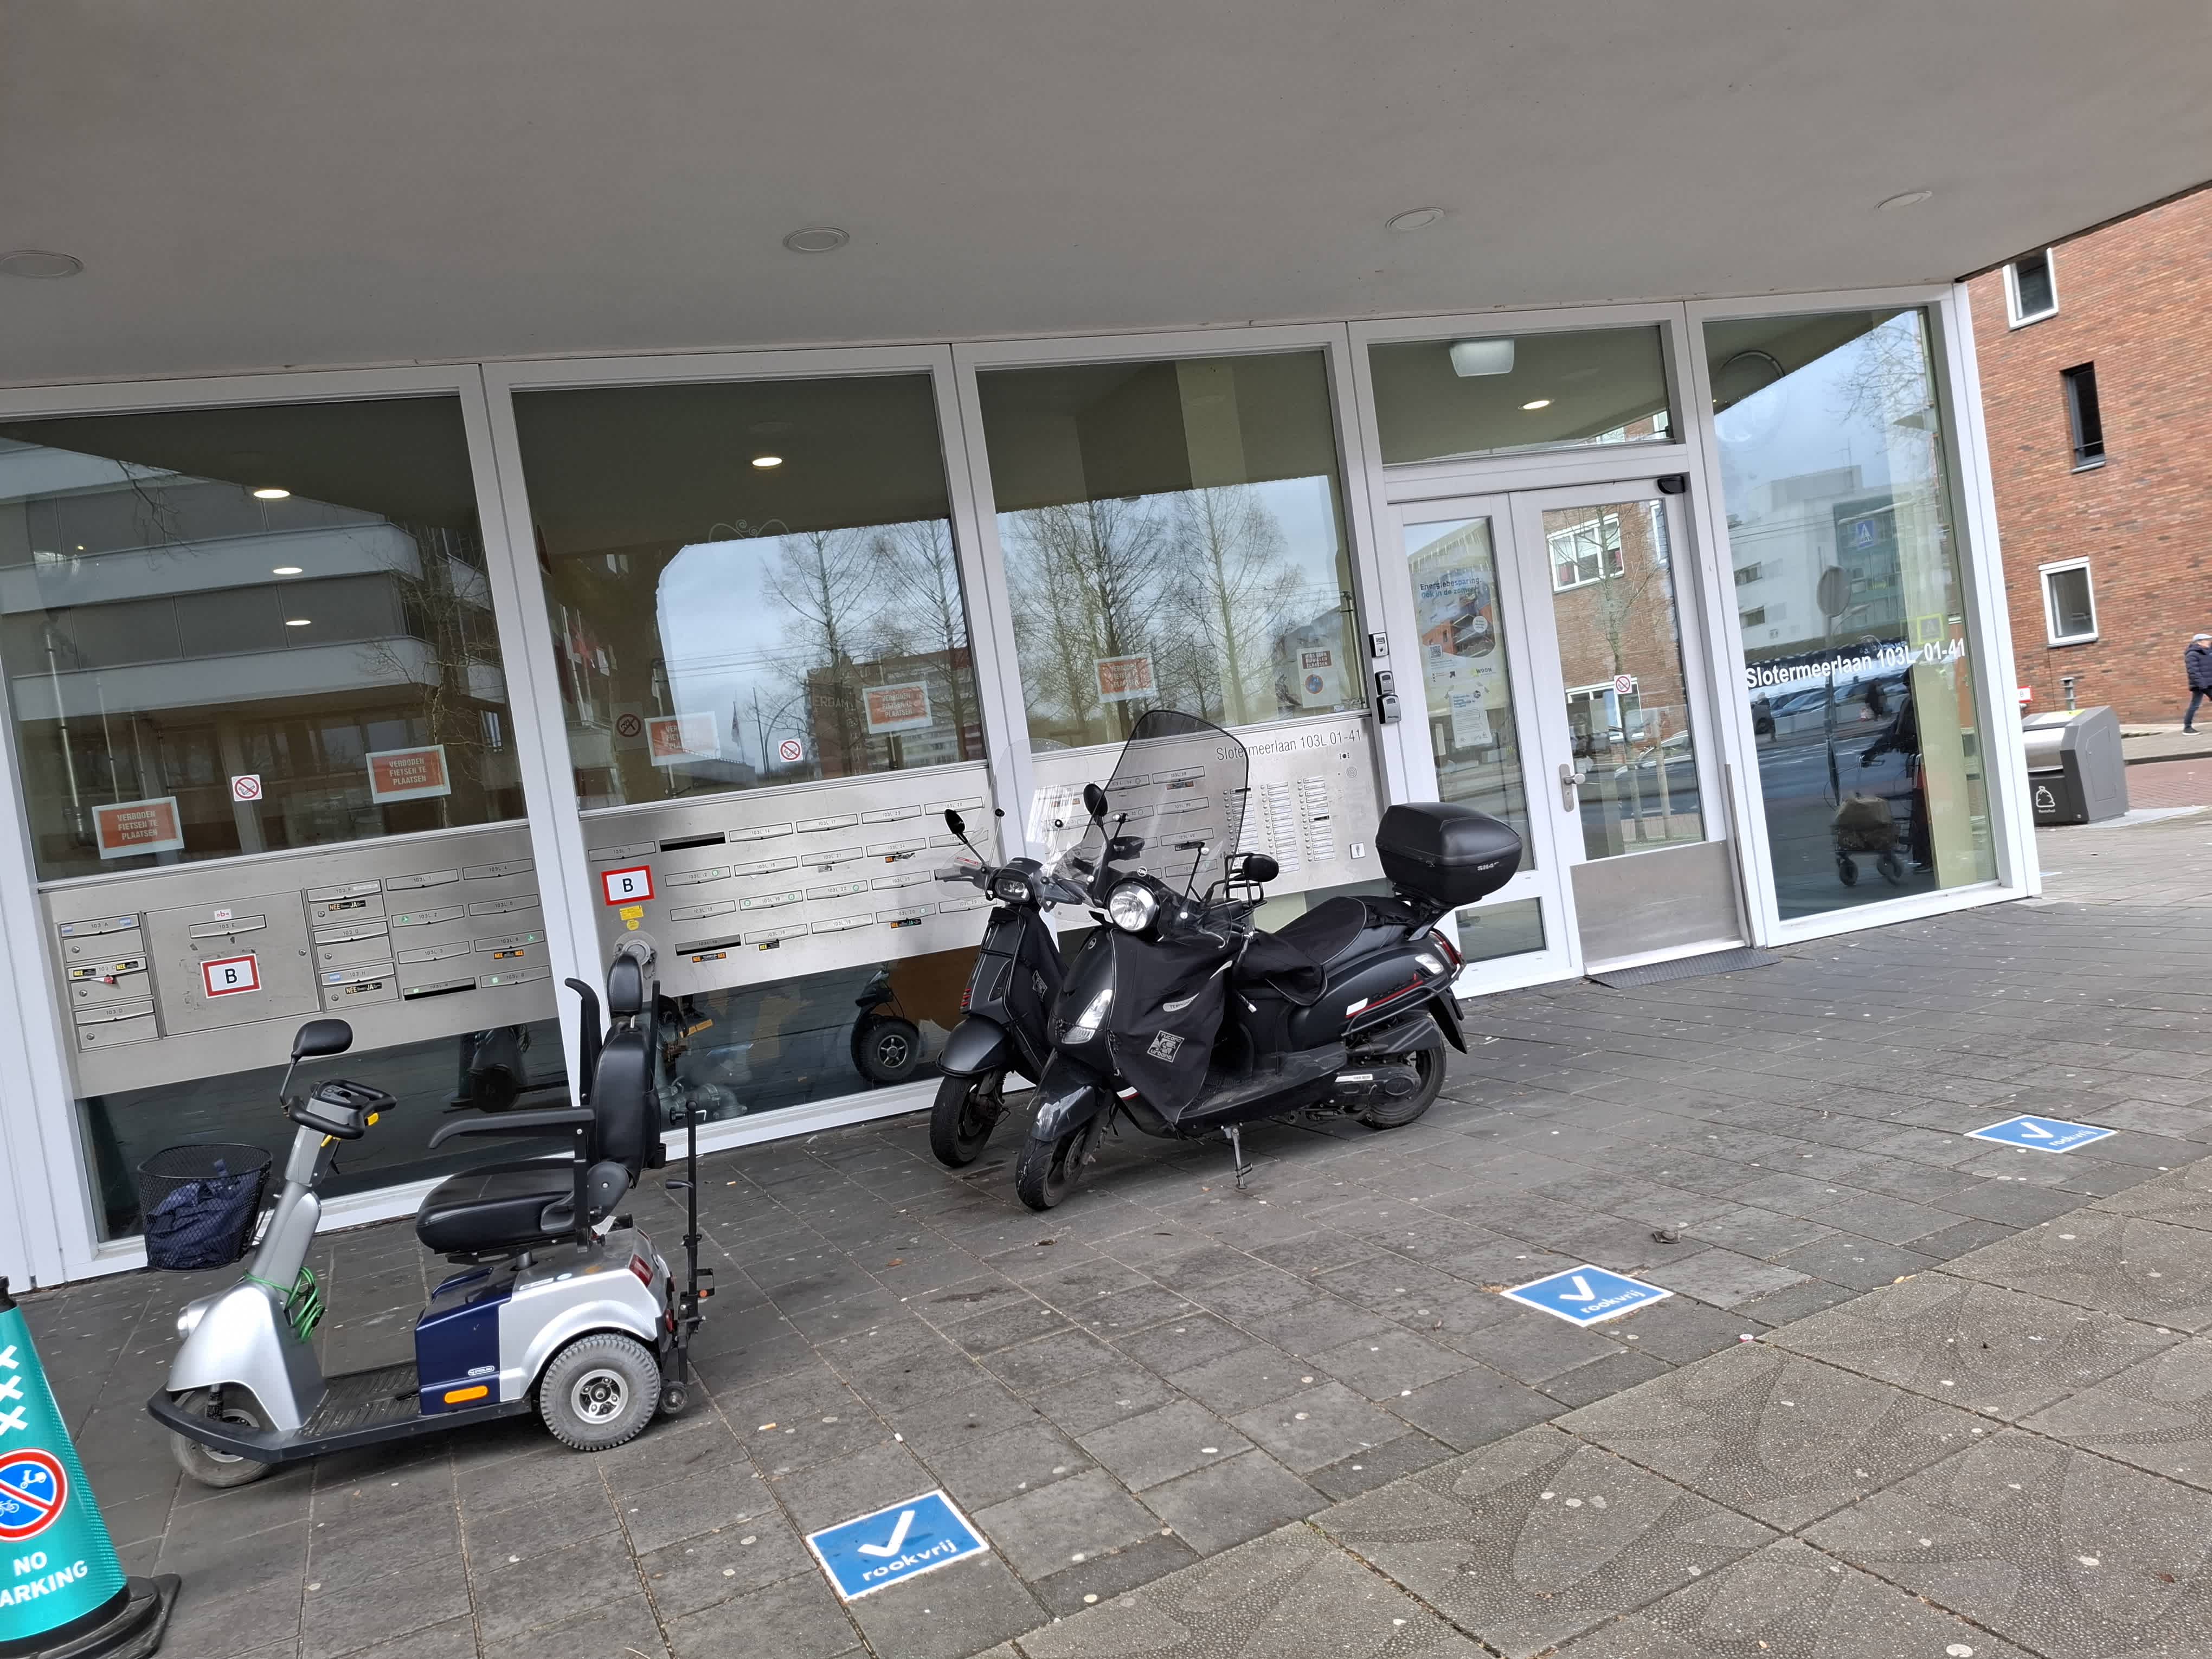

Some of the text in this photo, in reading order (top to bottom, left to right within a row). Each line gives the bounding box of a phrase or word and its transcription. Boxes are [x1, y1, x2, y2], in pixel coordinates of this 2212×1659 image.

[1745, 655, 1872, 687] Slotermeerlaan
[1877, 645, 1917, 668] 103L
[1924, 638, 1966, 661] 01-41
[1216, 729, 1361, 761] Slotemeerlaan 103L 01-41
[389, 757, 425, 768] VERBODEN
[389, 767, 417, 777] FIETSEN
[393, 775, 427, 786] PLAATSEN
[117, 810, 156, 822] VERBODEN
[118, 819, 159, 831] FIETSEN TE
[121, 829, 158, 840] PLAATSEN
[622, 878, 634, 893] B
[224, 968, 238, 984] B
[2048, 1129, 2099, 1147] rookvrij
[1580, 1289, 1647, 1314] rookvrij
[13, 1551, 48, 1577] NO
[862, 1539, 959, 1581] rookvrij
[0, 1560, 88, 1608] ARKING
